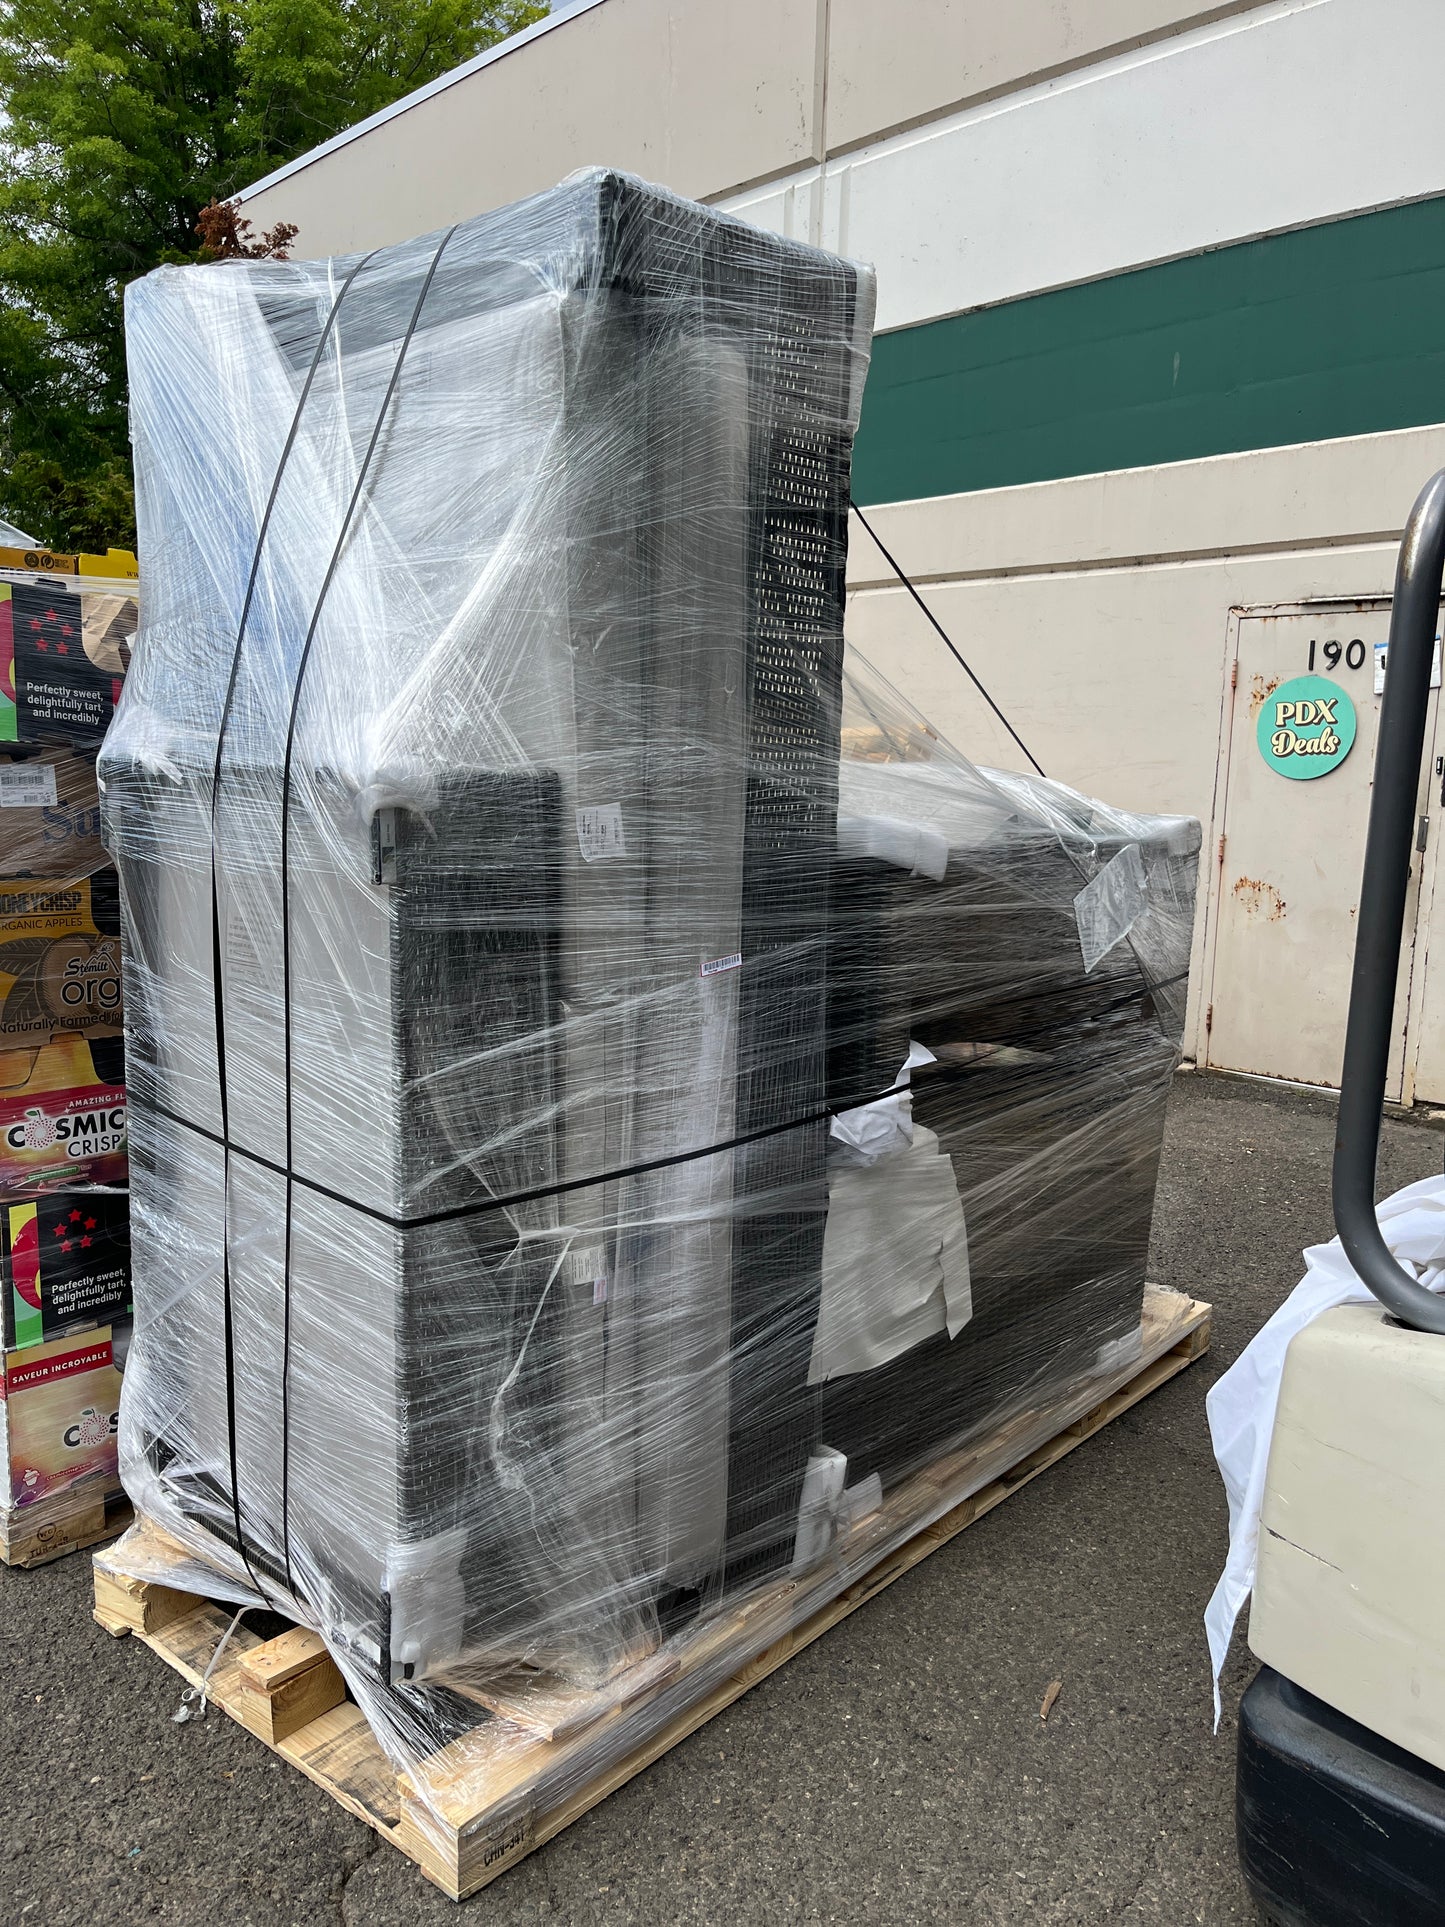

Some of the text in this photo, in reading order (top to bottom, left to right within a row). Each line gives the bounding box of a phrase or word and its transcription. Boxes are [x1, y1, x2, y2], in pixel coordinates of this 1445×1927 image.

[1308, 638, 1366, 671] 190
[26, 682, 104, 702] Perfectly sweet,
[27, 694, 104, 714] delightfully tart,
[33, 708, 100, 725] and incredibly
[1275, 698, 1339, 727] PDX
[1271, 726, 1342, 758] Deals
[45, 917, 83, 929] APPLES
[63, 957, 109, 978] Stemilt
[61, 976, 121, 1010] org
[0, 1018, 56, 1034] Naturally
[60, 1011, 107, 1027] Farmed
[69, 1094, 112, 1108] AMAZING
[8, 1108, 125, 1149] COSMIC
[51, 1268, 126, 1294] Perfectly sweet,
[52, 1279, 127, 1305] delightfully tart,
[57, 1291, 122, 1315] and incredibly
[12, 1350, 108, 1384] SAVEUR INCROYABLE
